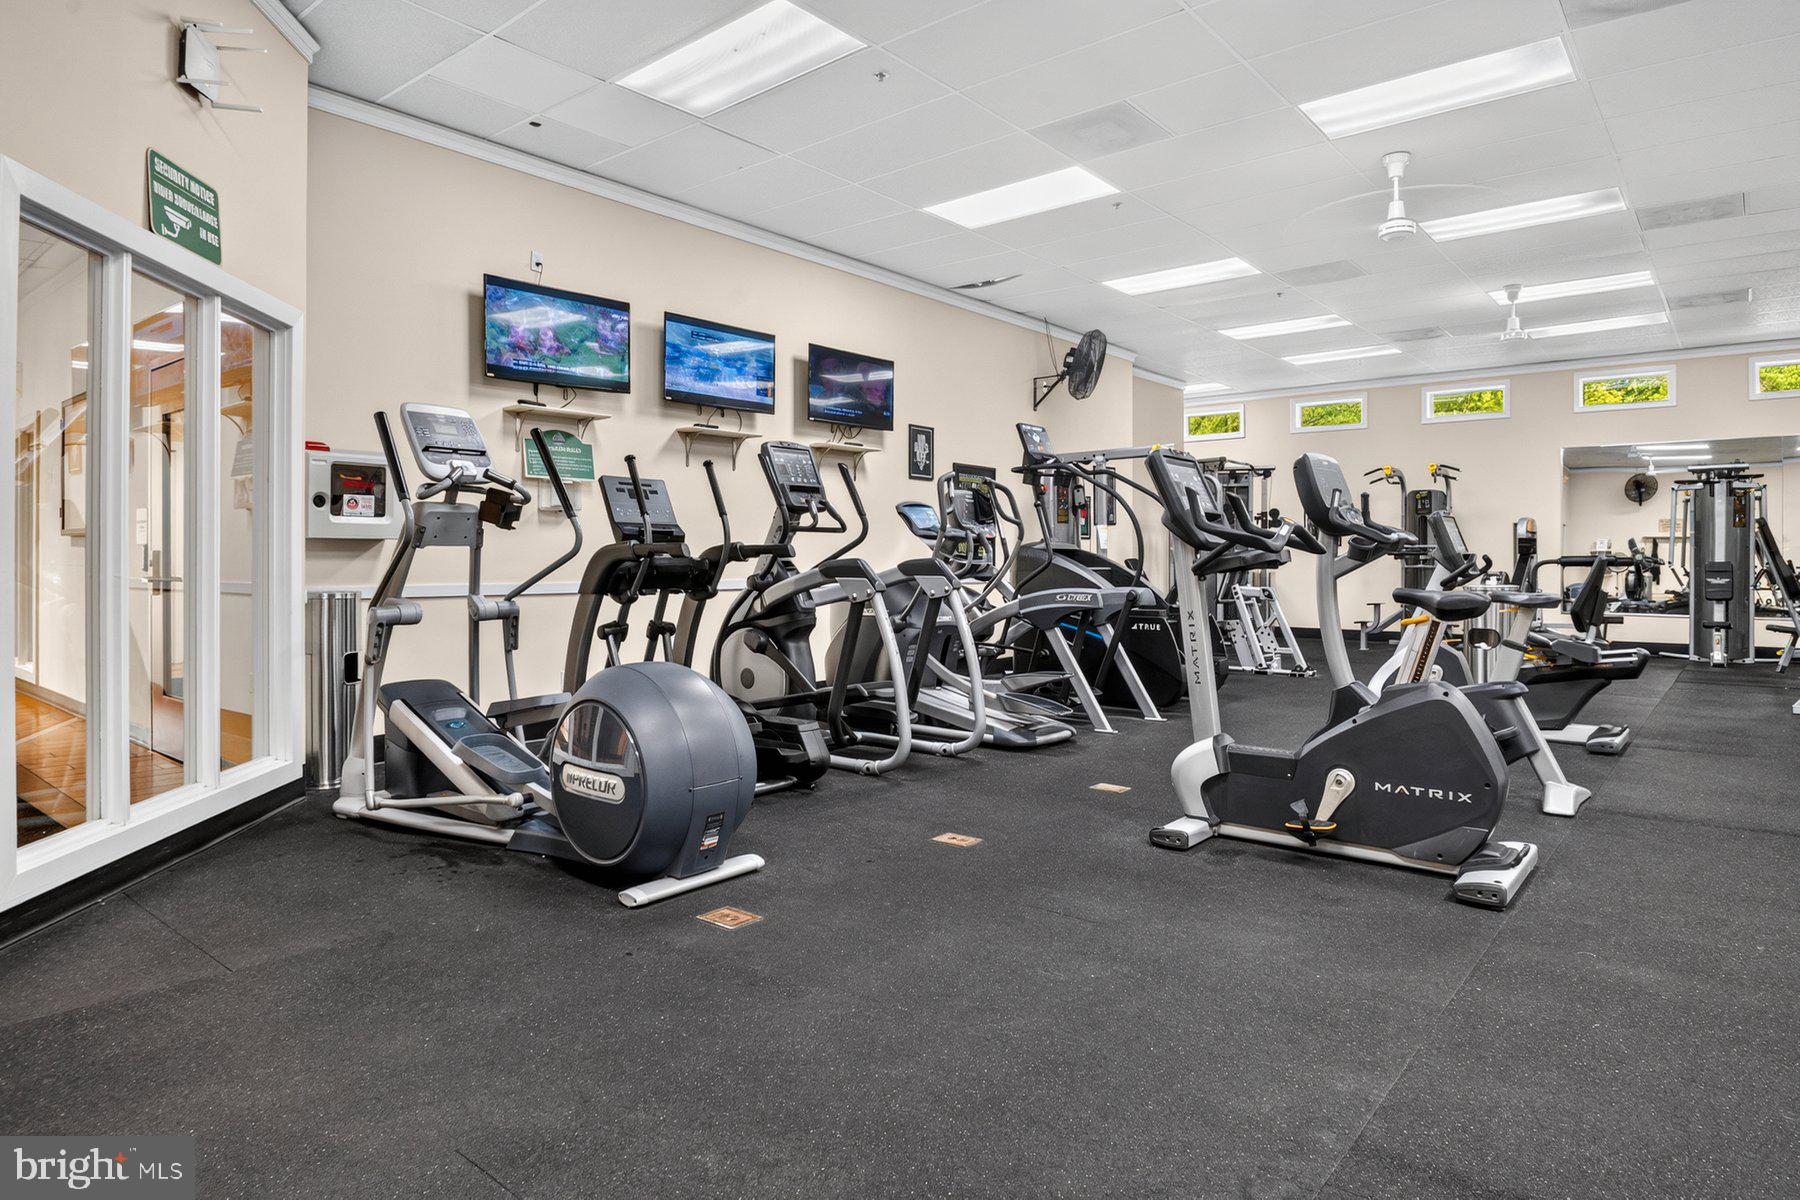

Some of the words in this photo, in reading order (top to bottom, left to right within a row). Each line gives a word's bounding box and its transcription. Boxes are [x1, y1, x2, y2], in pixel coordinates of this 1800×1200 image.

[1139, 623, 1161, 631] TRUE
[1187, 610, 1201, 685] MATRIX
[1374, 782, 1472, 803] MATRIX
